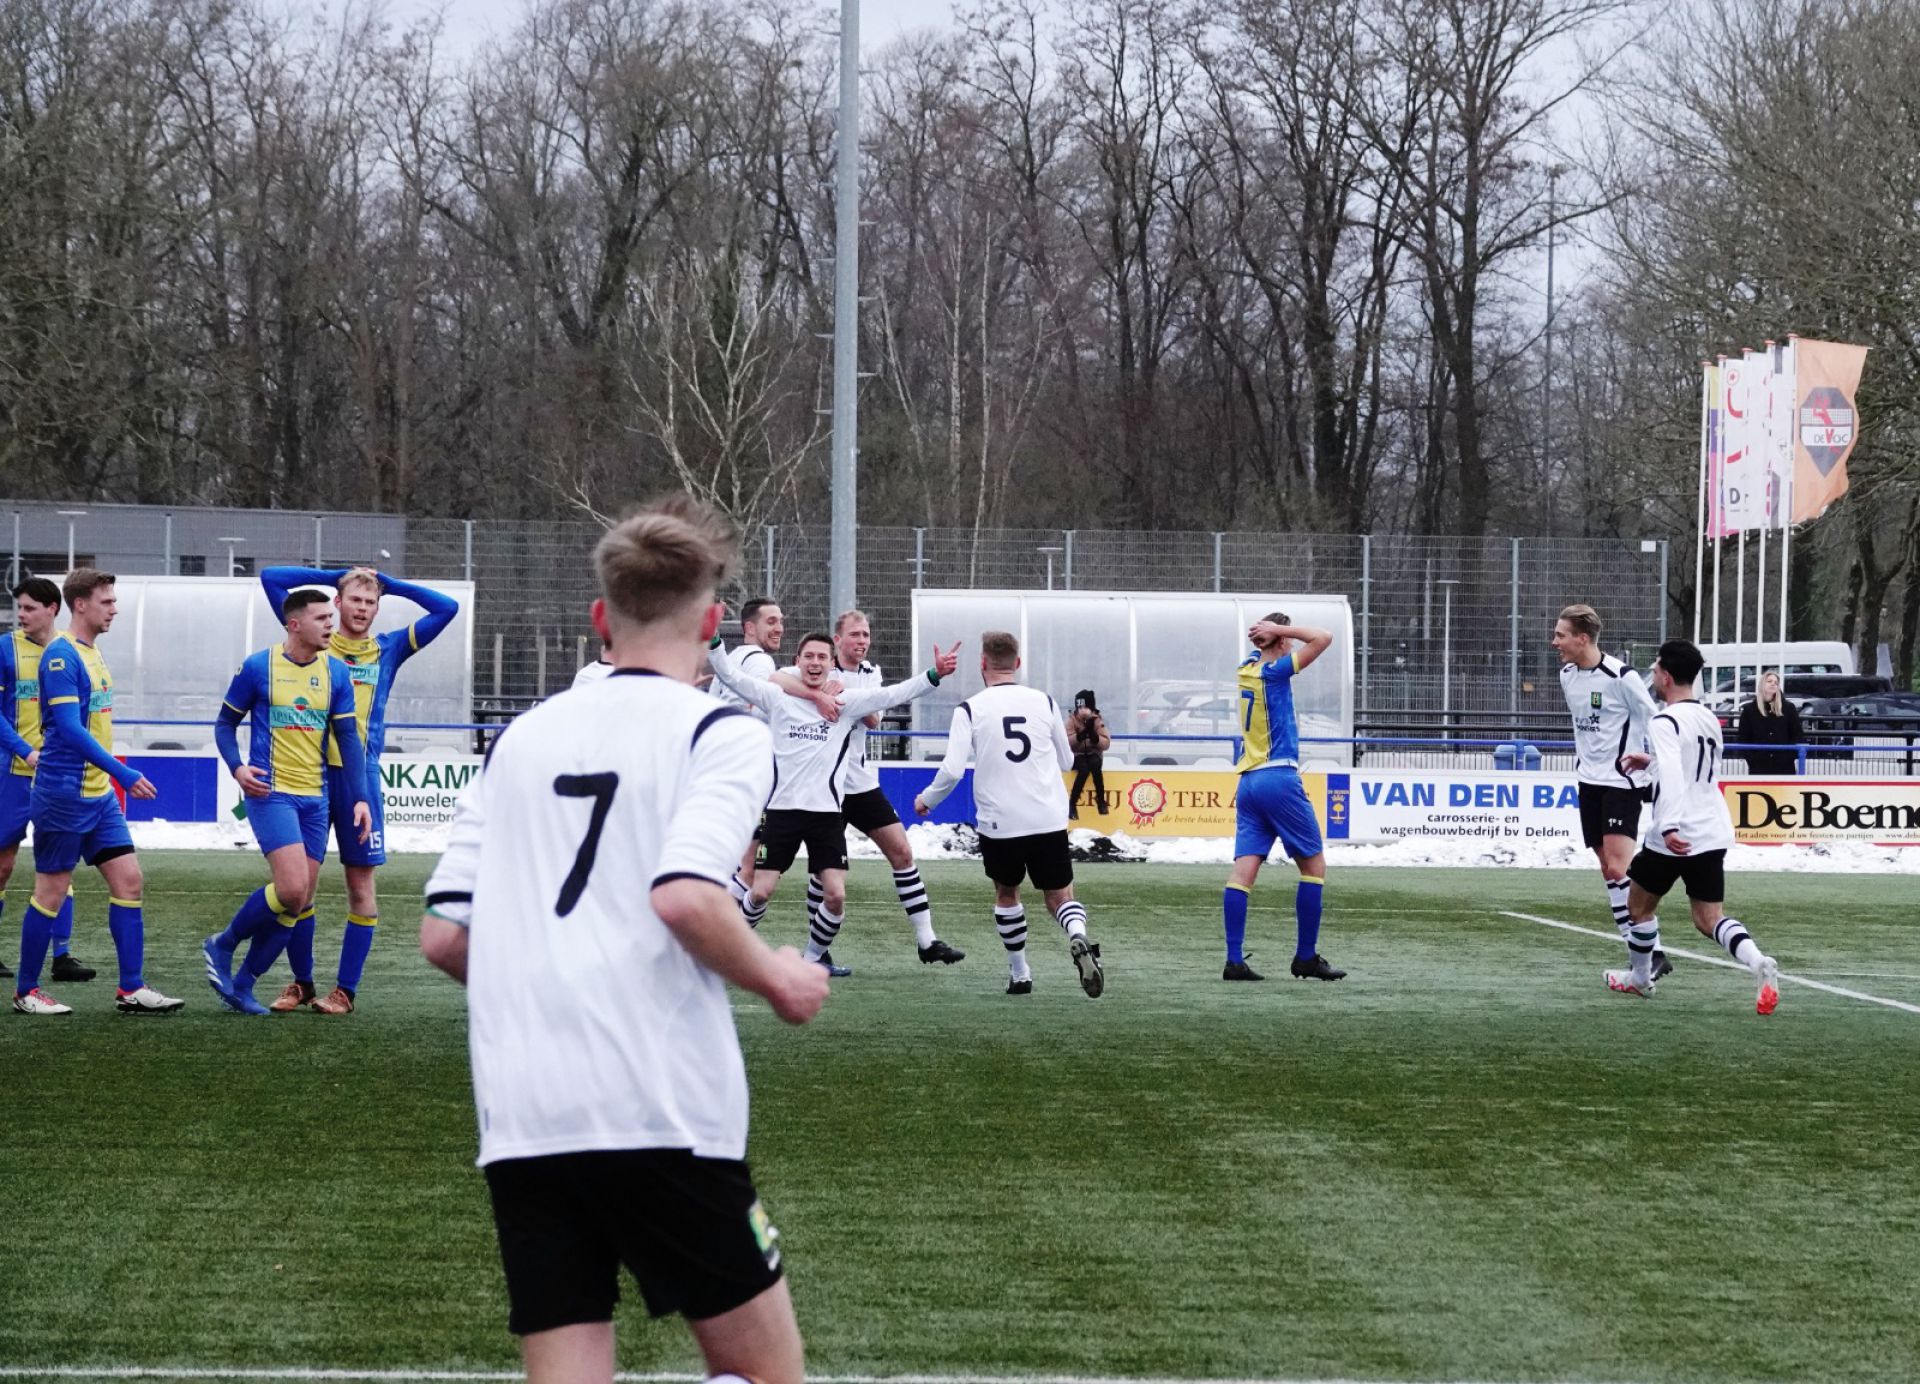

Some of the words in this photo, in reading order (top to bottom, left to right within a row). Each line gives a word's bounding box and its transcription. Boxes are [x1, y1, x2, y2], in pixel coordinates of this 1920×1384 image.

[1241, 689, 1255, 732] 7
[1002, 716, 1032, 763] 5
[1173, 790, 1222, 808] TER
[1361, 782, 1435, 807] VAN
[1450, 784, 1519, 808] DEN
[1427, 813, 1500, 824] carrosserie-
[1504, 814, 1519, 824] en
[369, 830, 382, 849] 15
[1380, 825, 1500, 838] wagenbouwbedrijf
[1504, 826, 1519, 837] bv
[1525, 827, 1569, 838] Delden
[1749, 831, 1769, 839] adres
[1846, 832, 1874, 841] partijen
[552, 771, 620, 918] 7
